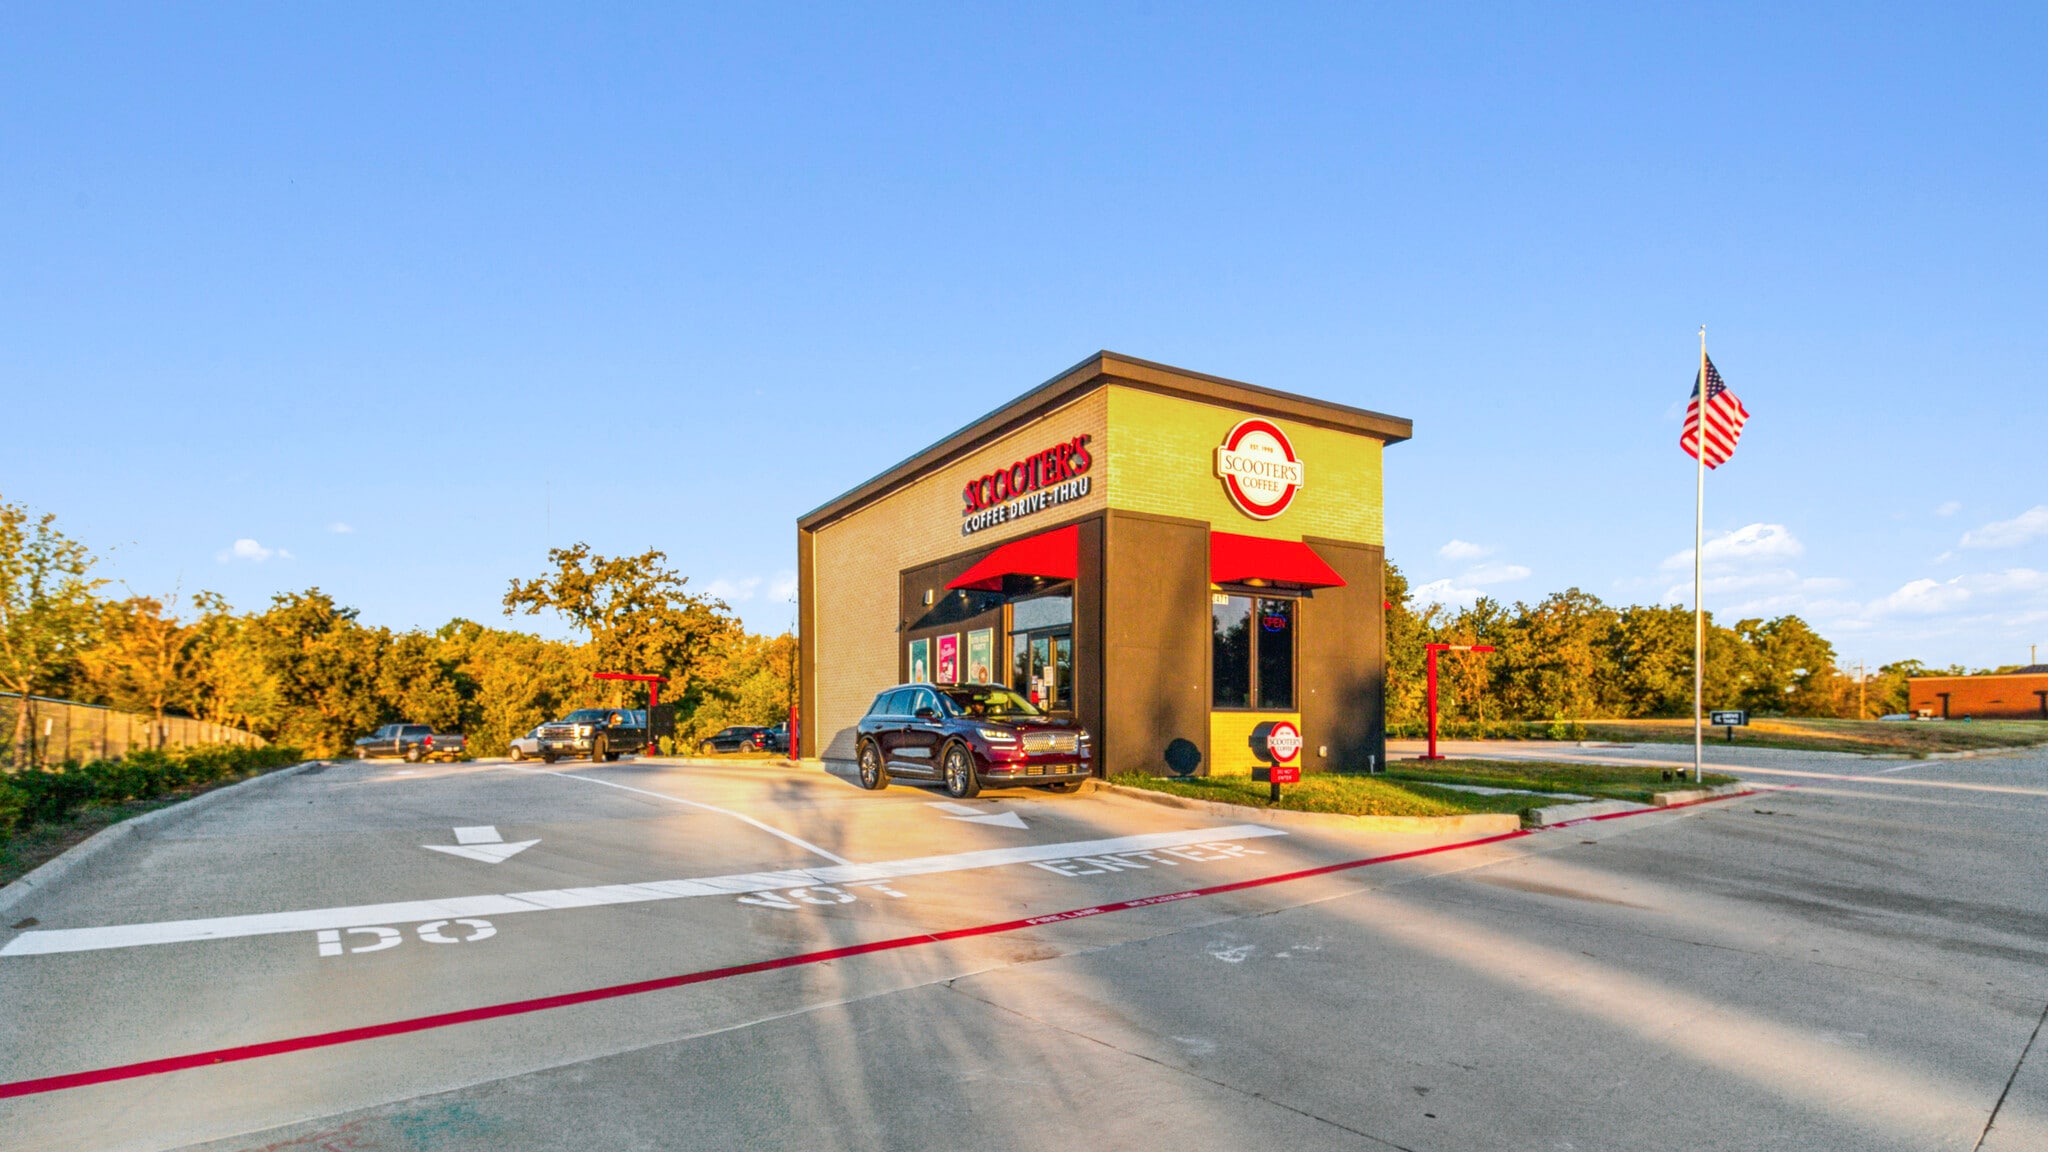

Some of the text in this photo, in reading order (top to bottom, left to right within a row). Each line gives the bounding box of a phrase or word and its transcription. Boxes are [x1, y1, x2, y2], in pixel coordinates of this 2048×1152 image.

[965, 433, 1091, 513] SCOOTER'S
[1225, 455, 1297, 481] SCOOTER'S
[1243, 477, 1279, 492] COFFEE
[964, 476, 1089, 533] COFFEE DRIVE-THRU
[317, 918, 498, 957] DO
[1030, 843, 1266, 877] ENTER
